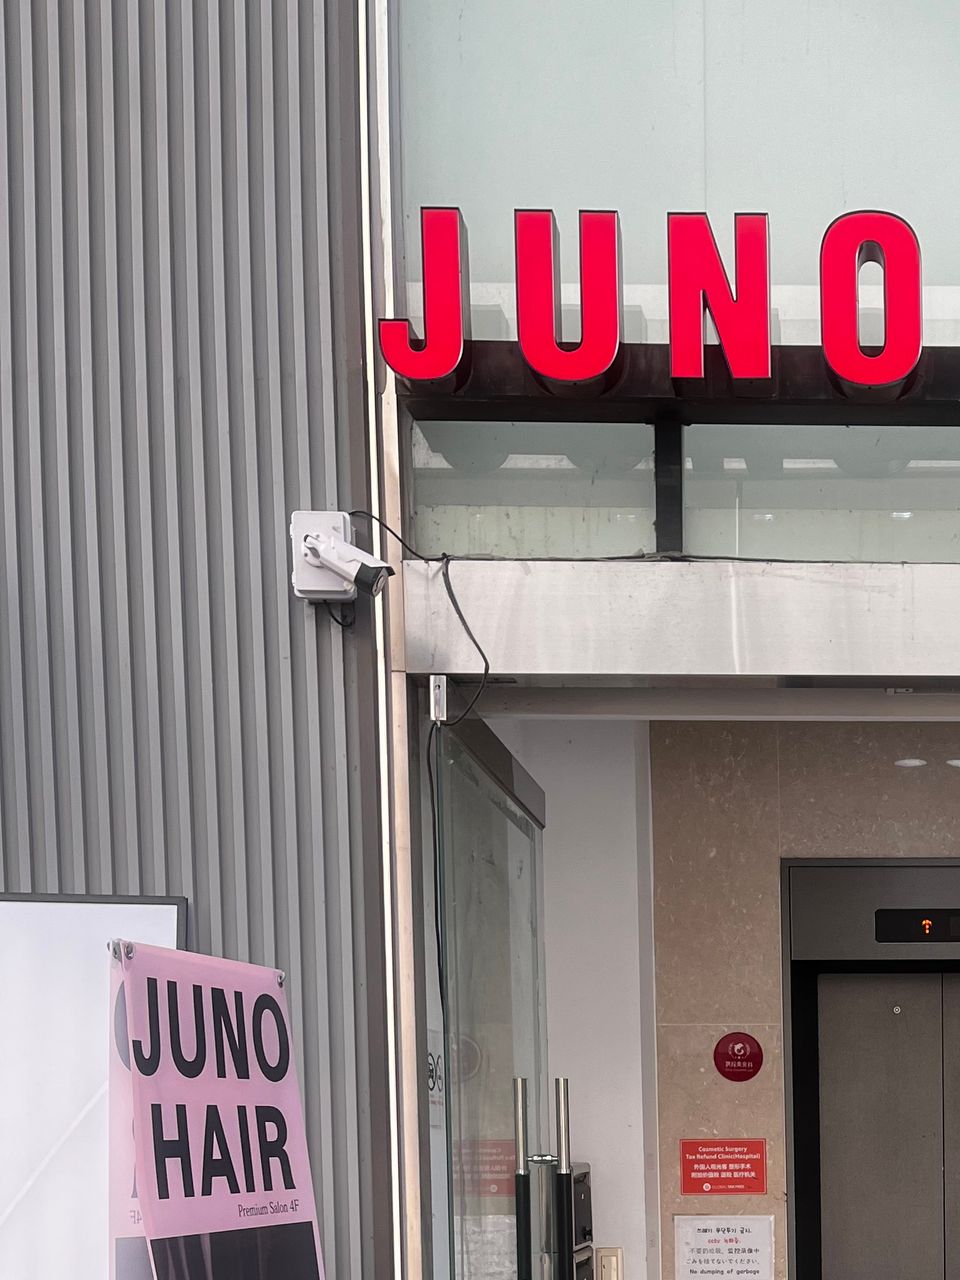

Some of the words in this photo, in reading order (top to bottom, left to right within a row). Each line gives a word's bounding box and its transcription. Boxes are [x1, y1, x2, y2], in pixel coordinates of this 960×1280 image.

[378, 206, 923, 386] JUNO
[132, 976, 290, 1082] JUNO
[150, 1103, 297, 1200] HAIR
[725, 1146, 748, 1154] Surgery
[238, 1202, 269, 1217] Premium
[269, 1201, 288, 1215] Salon
[289, 1199, 299, 1212] 4F
